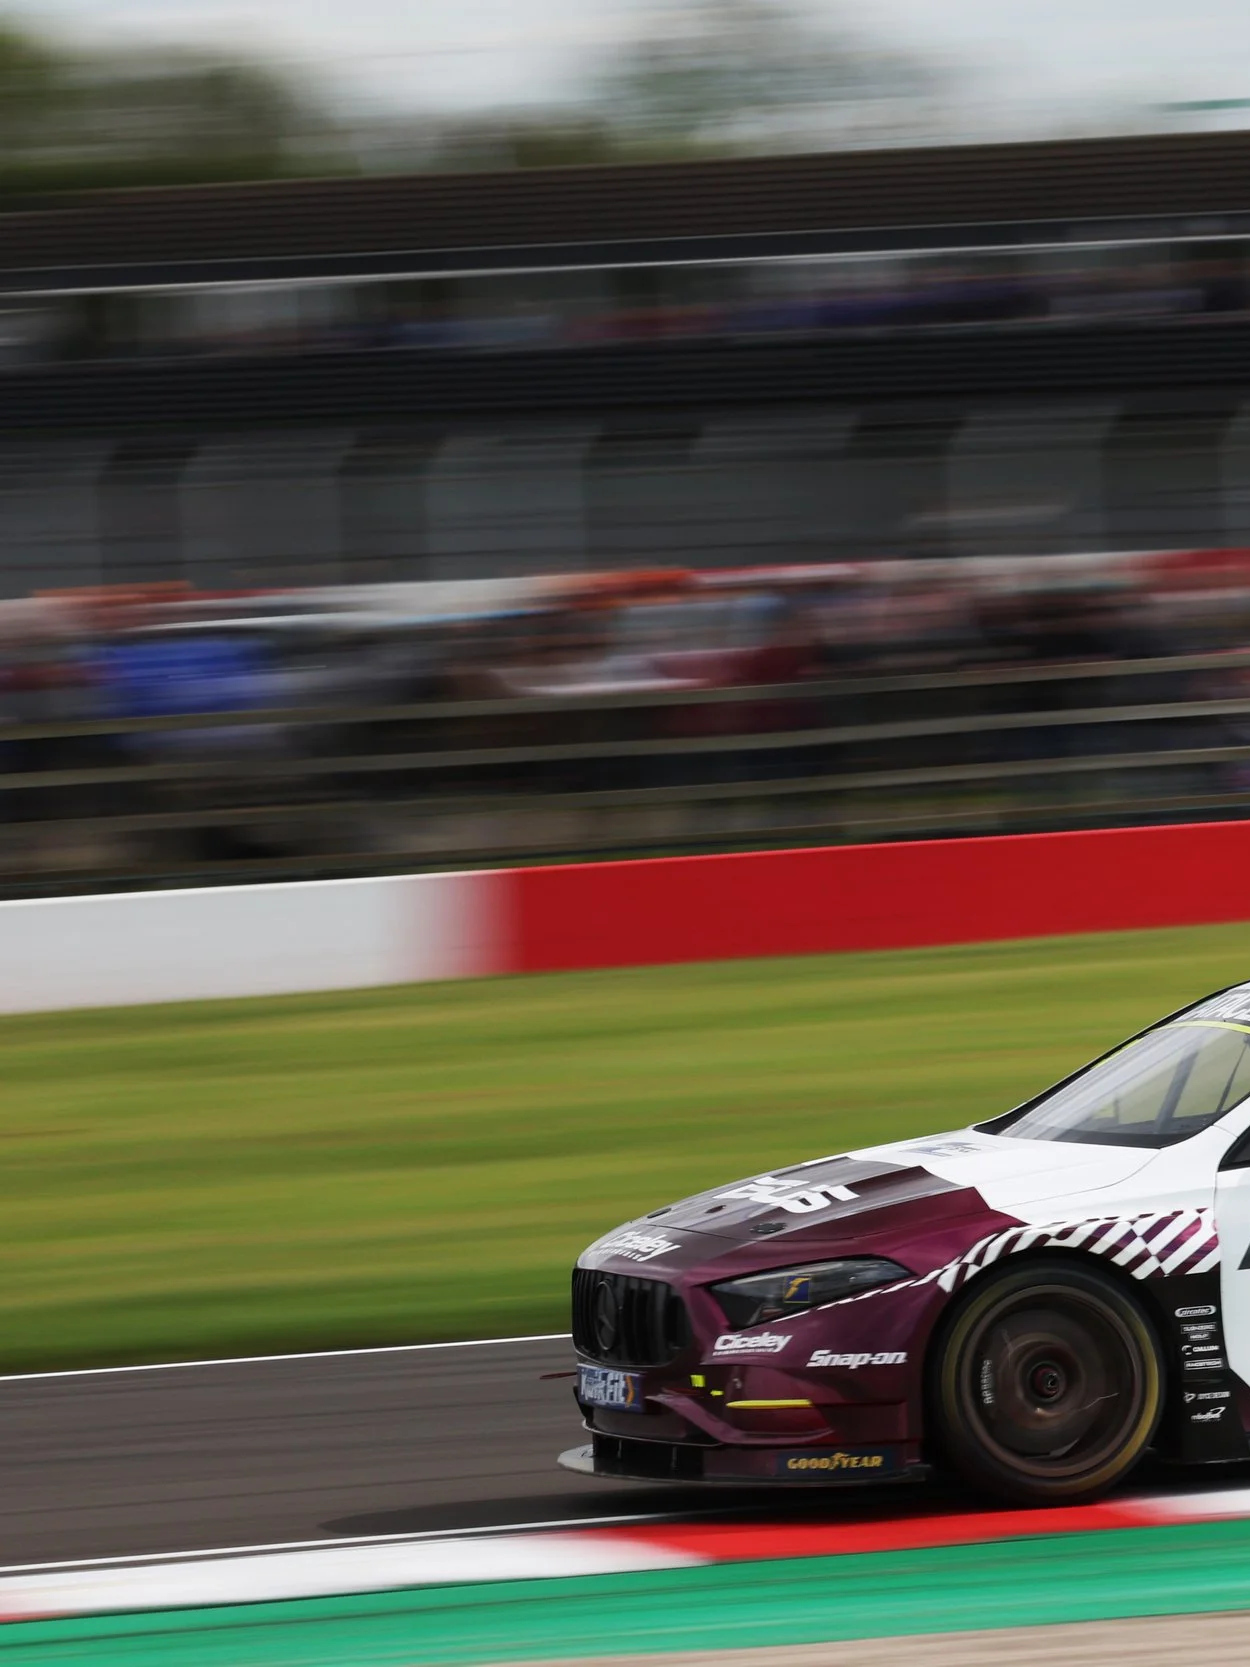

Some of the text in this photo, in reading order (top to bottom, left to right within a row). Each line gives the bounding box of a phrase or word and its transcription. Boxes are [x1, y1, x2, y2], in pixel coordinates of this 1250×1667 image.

[714, 1331, 793, 1353] Ciceley
[805, 1349, 907, 1369] Snap-on
[787, 1452, 883, 1470] GOODYEAR
